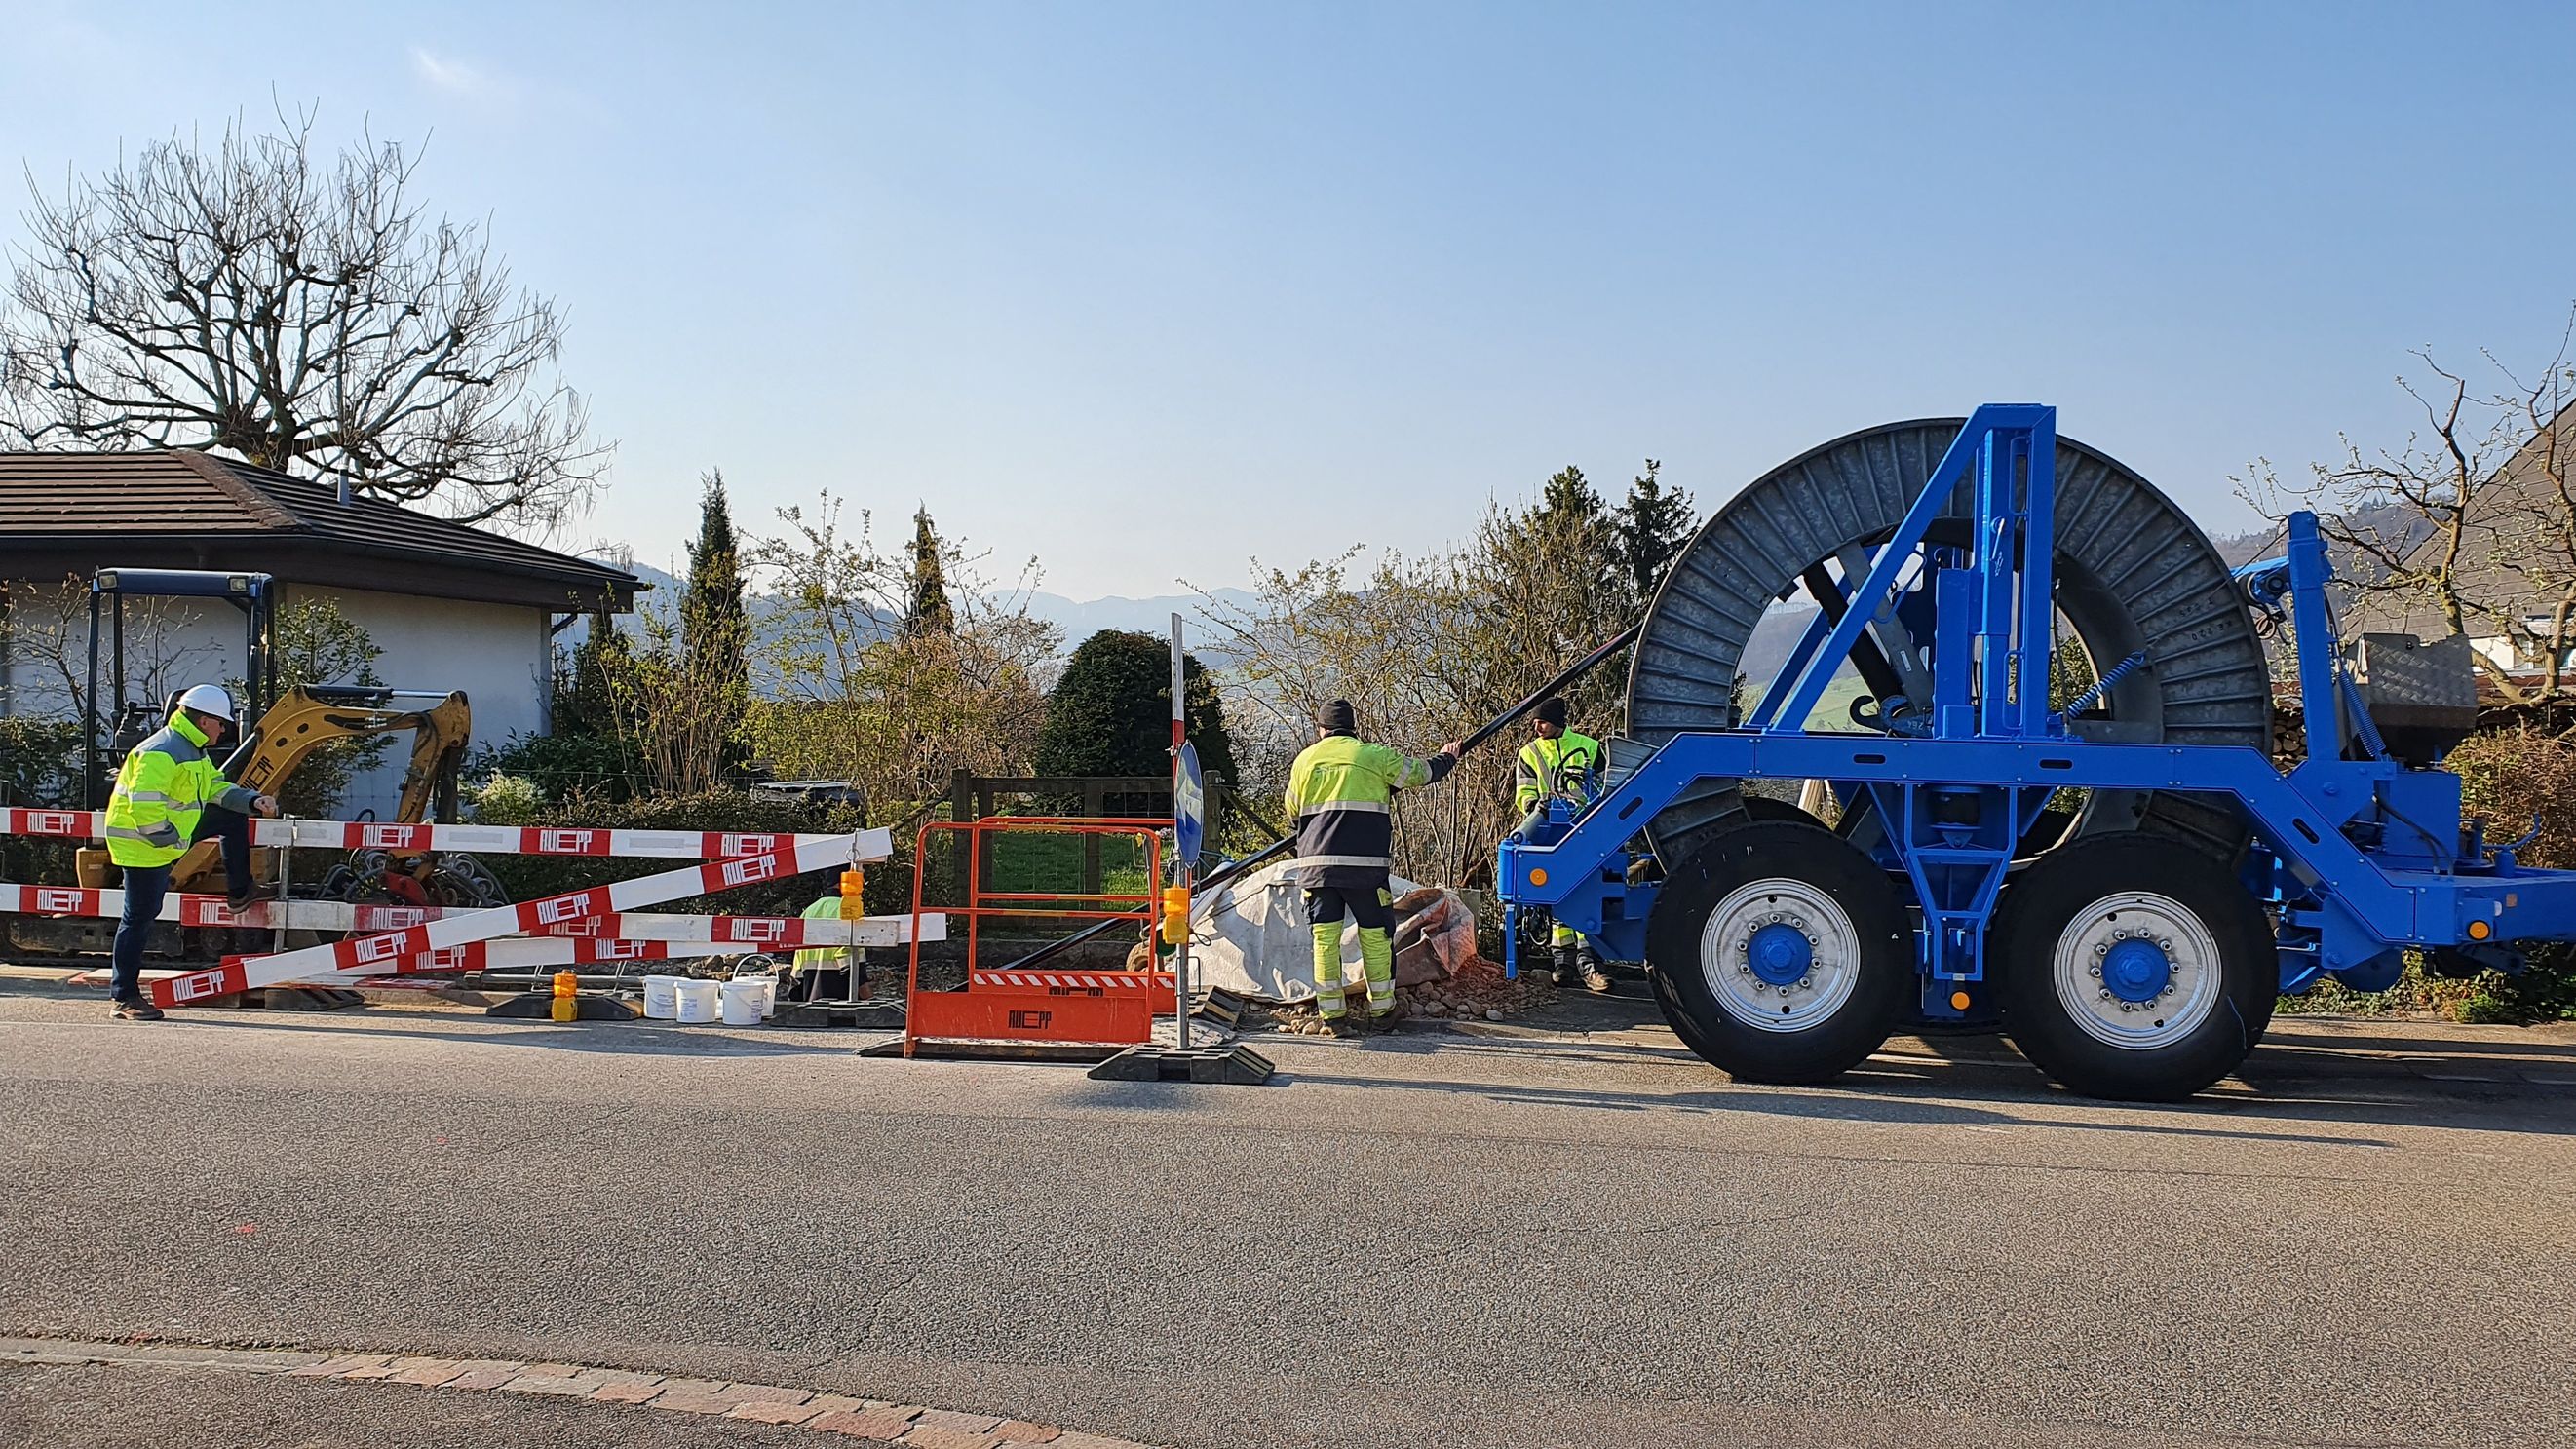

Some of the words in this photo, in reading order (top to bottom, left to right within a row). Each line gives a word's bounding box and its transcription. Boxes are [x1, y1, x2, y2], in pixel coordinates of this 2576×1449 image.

[28, 812, 74, 833] RUEPP
[363, 825, 413, 846] RUEPP
[540, 829, 592, 852] RUEPP
[722, 853, 777, 886] RUEPP
[38, 889, 83, 912] RUEPP
[536, 893, 590, 924] RUEPP
[732, 918, 786, 941] RUEPP
[355, 930, 407, 964] RUEPP
[171, 971, 226, 1003] RUEPP
[1009, 1009, 1052, 1029] RUEPP
